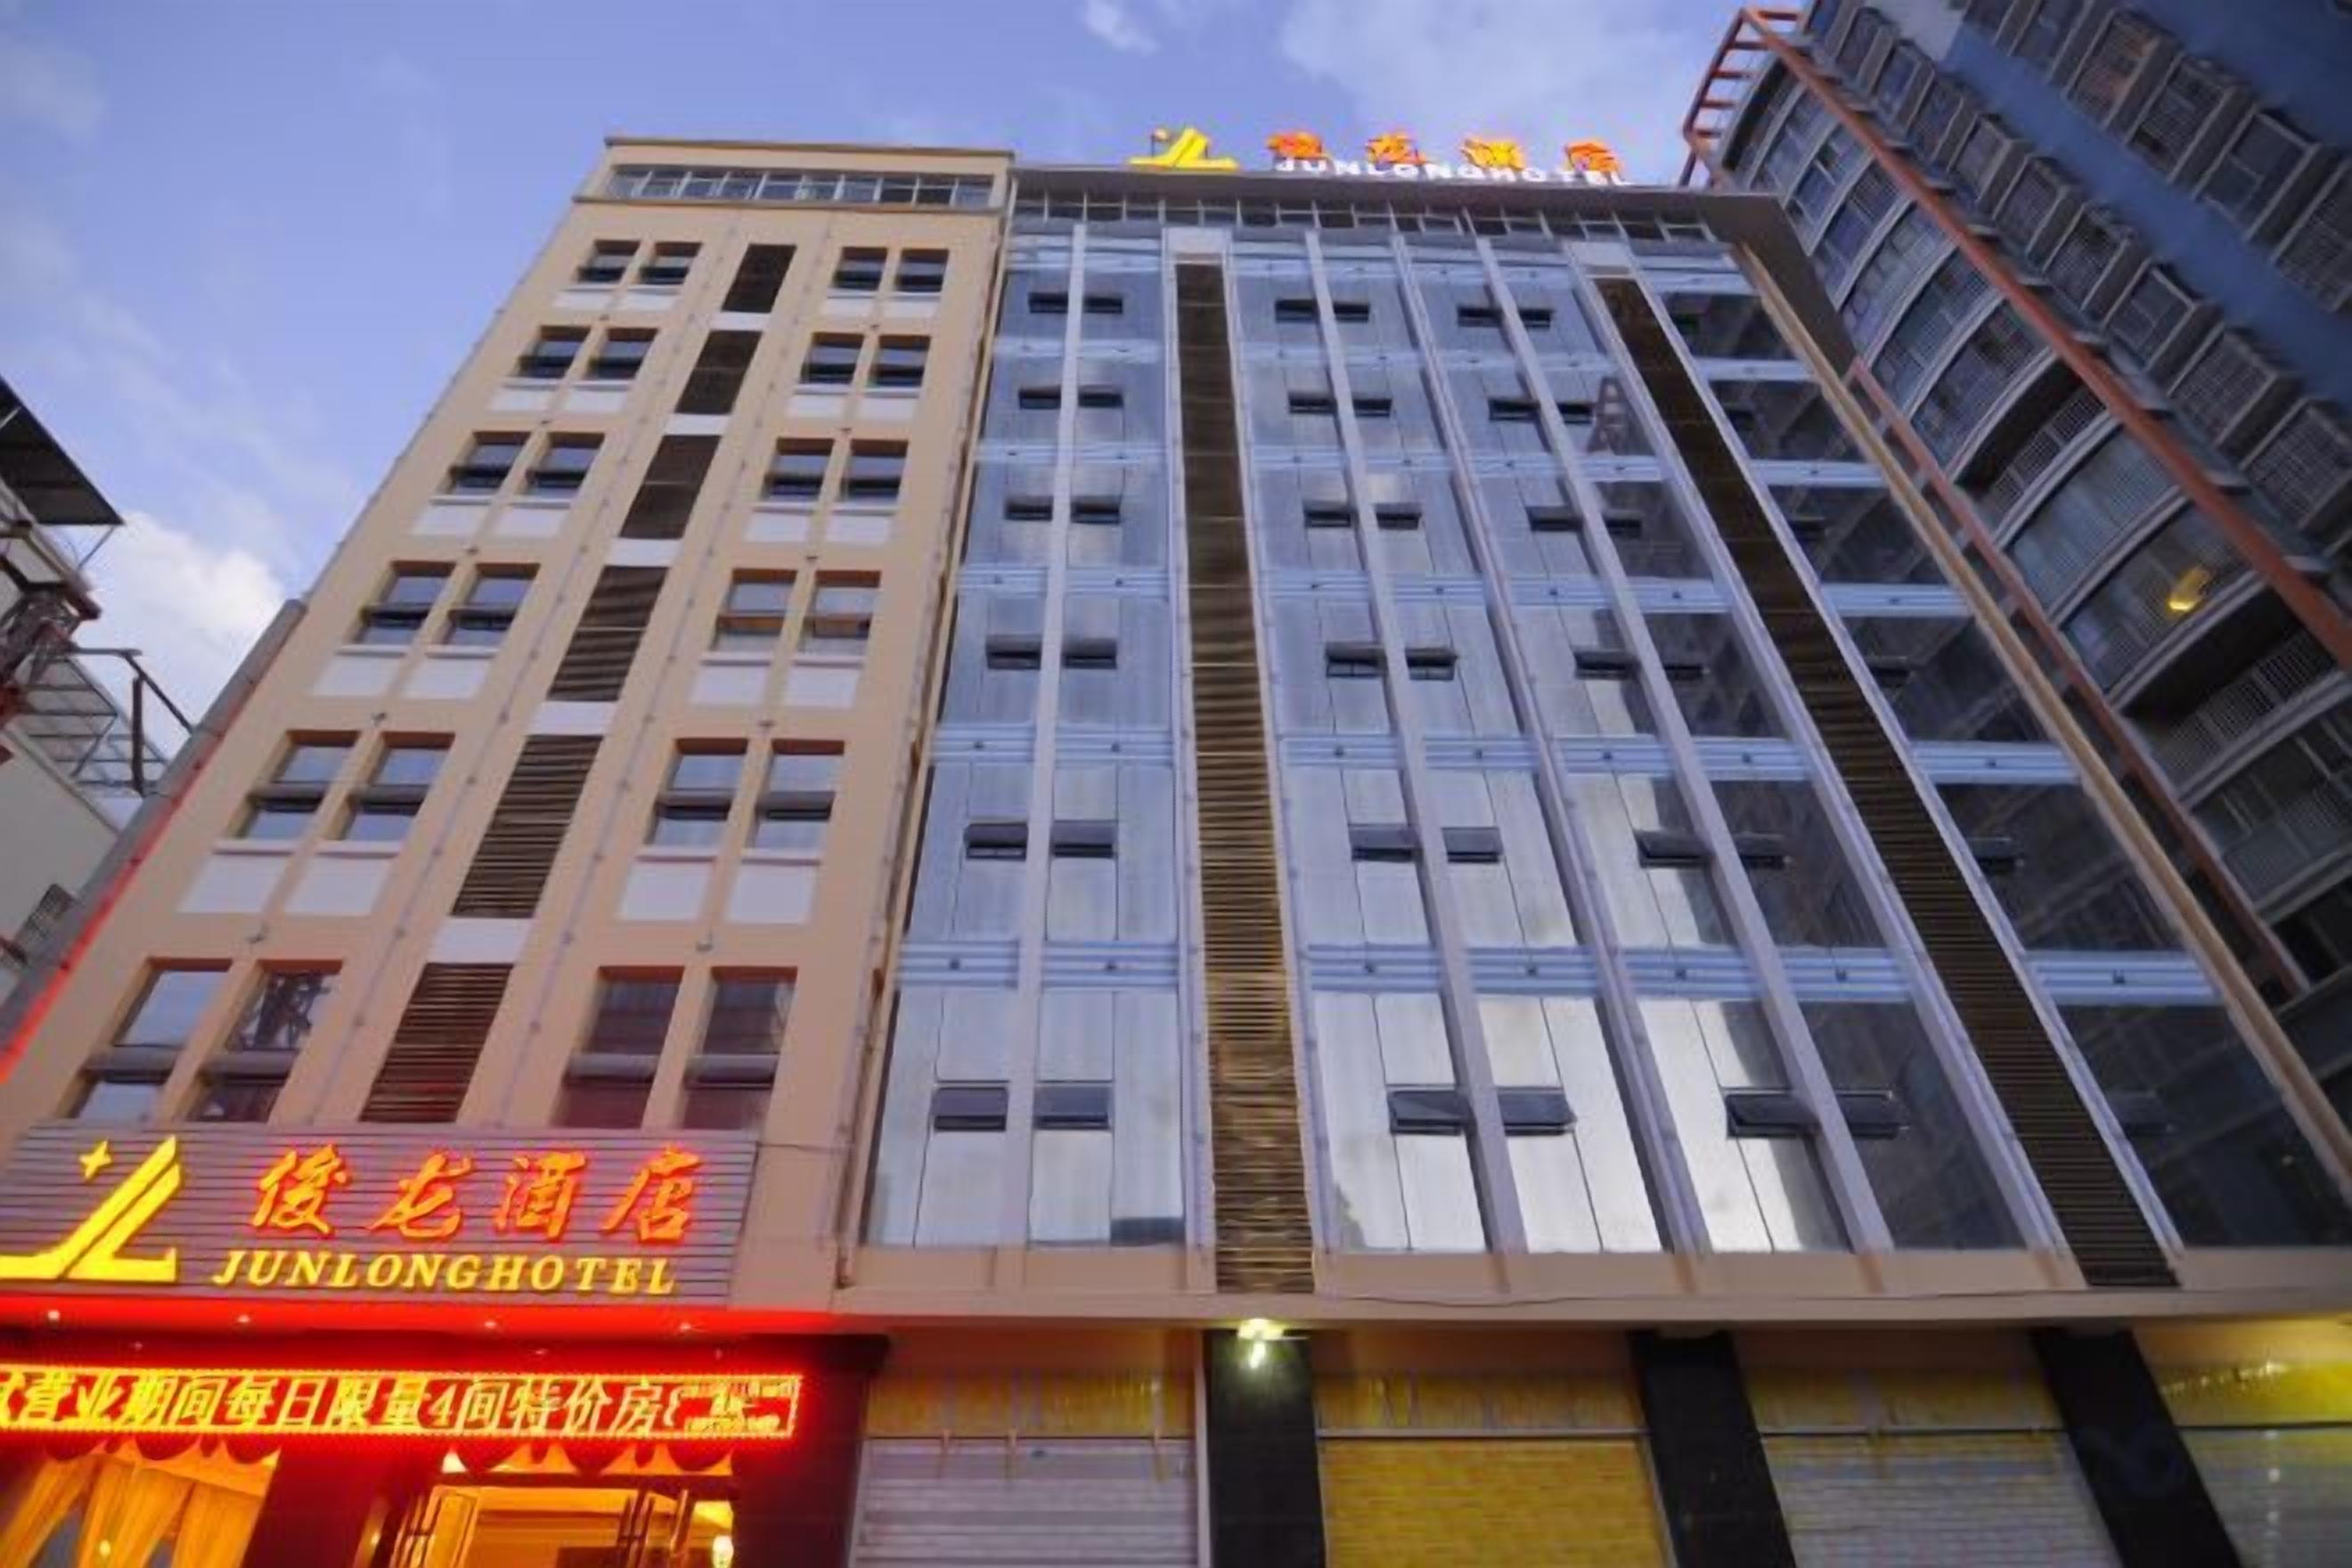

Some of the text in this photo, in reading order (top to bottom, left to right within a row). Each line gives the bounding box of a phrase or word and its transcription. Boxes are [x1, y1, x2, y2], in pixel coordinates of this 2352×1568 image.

[250, 1144, 699, 1241] 俊龙酒店
[212, 1250, 676, 1295] JUNLONGHOTEL
